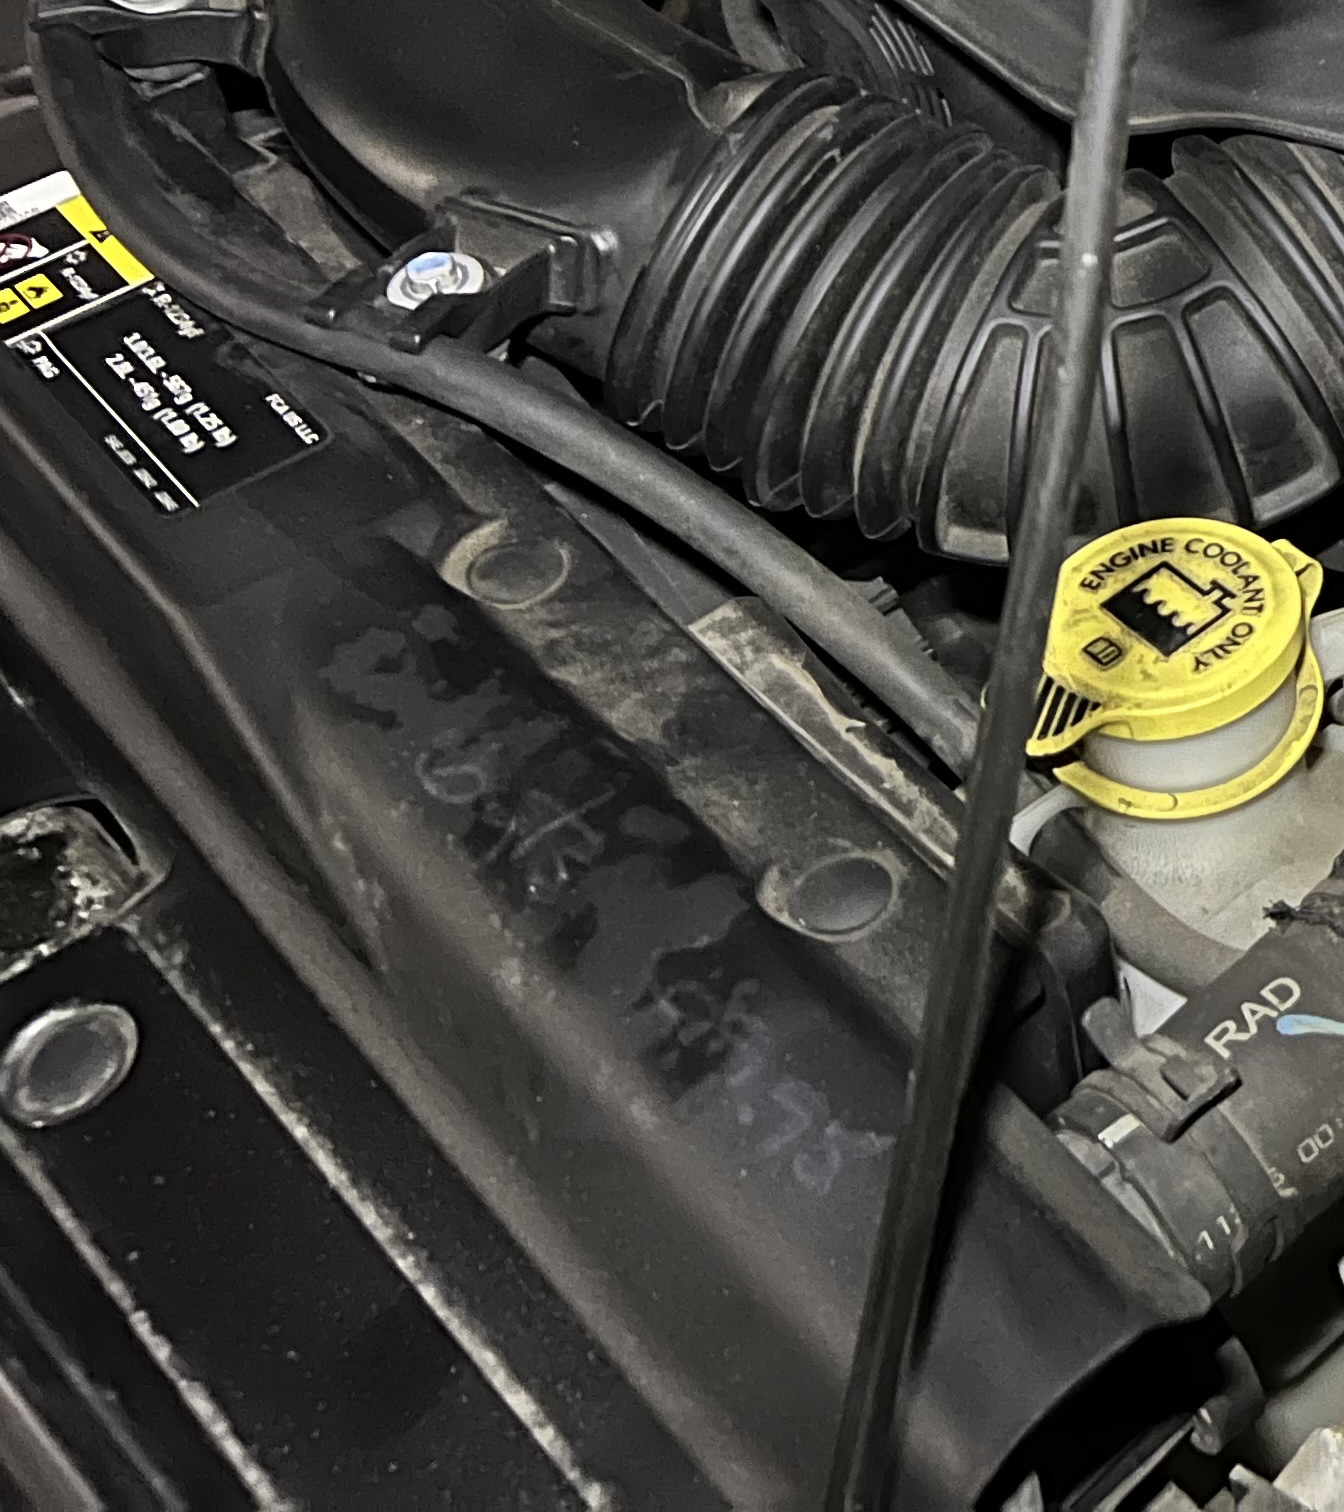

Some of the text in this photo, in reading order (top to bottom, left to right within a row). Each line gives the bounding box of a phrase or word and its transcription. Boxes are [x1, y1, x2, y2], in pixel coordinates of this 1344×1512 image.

[1079, 537, 1265, 673] ENGINE COOLANT ONLY
[1203, 976, 1302, 1059] RAD
